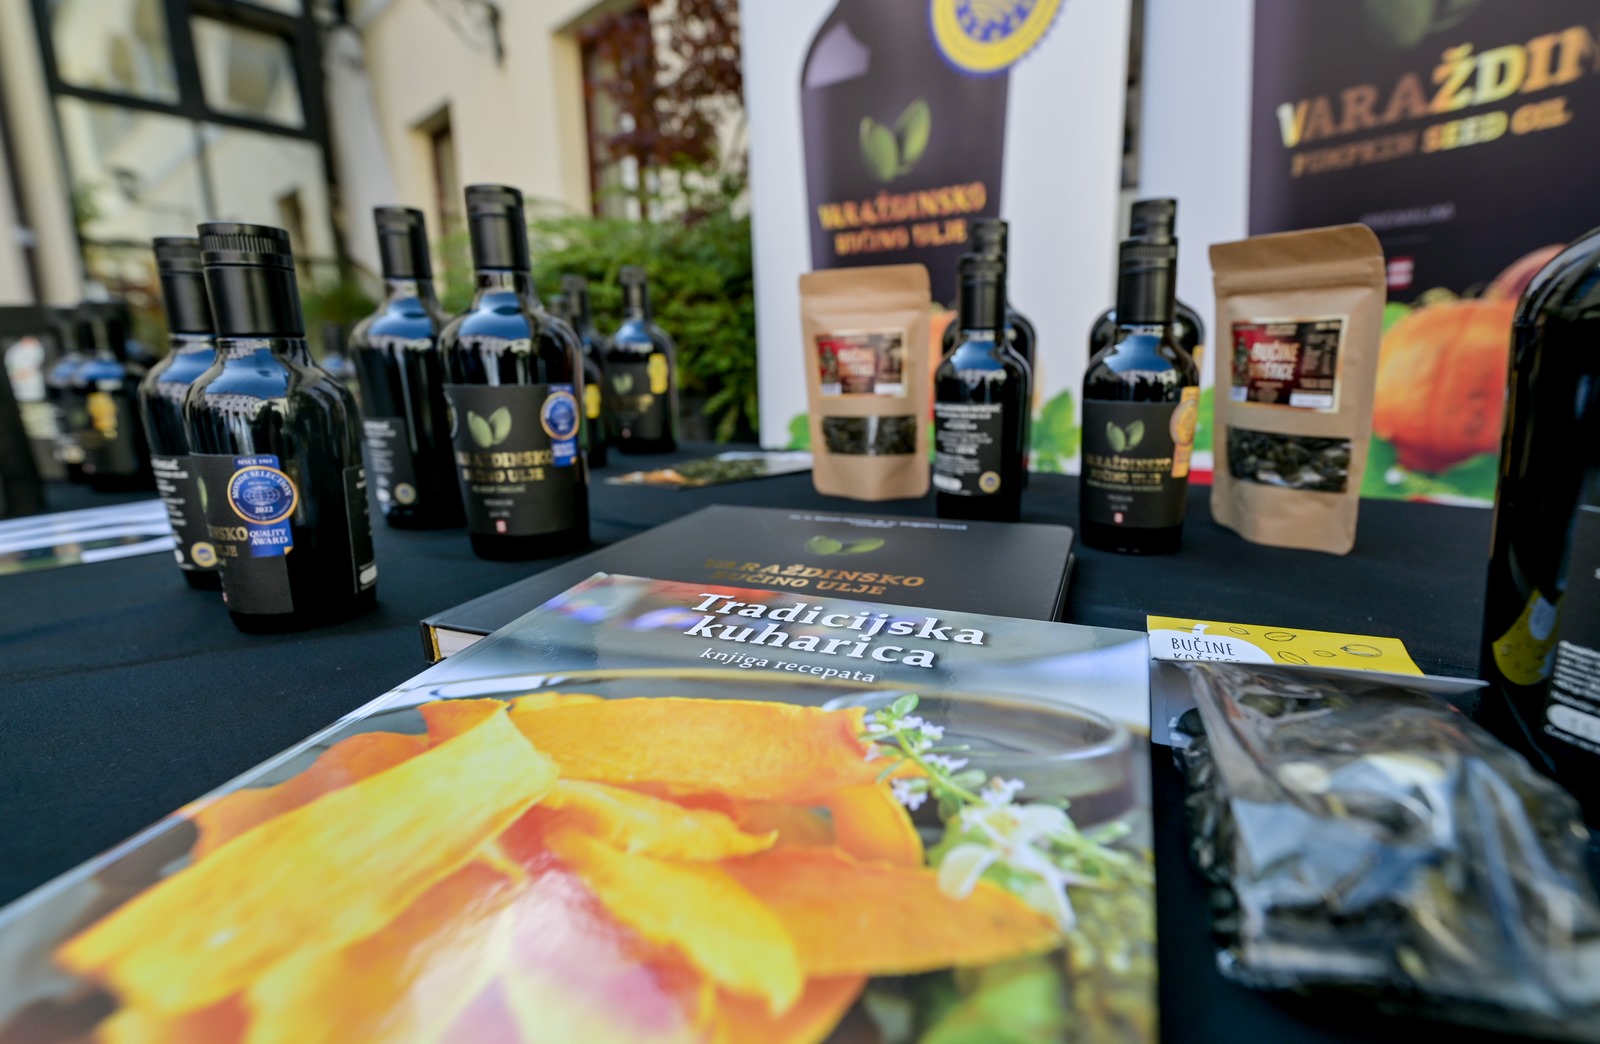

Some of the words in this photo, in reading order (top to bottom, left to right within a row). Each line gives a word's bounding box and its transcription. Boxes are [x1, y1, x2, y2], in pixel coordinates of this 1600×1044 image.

[1421, 109, 1509, 154] SEED
[1511, 96, 1573, 135] OIL
[237, 458, 258, 466] SINCE
[232, 473, 250, 500] MONDE
[249, 469, 293, 498] SELECTION
[254, 506, 274, 514] 2022
[249, 528, 287, 539] QUALITY
[251, 536, 289, 546] AWARD
[815, 580, 888, 596] ULJE
[691, 593, 986, 646] Tradicijska
[683, 614, 939, 669] kuharica
[1170, 636, 1236, 656] BUČINE
[698, 647, 770, 671] knjiga
[773, 660, 877, 684] recepata
